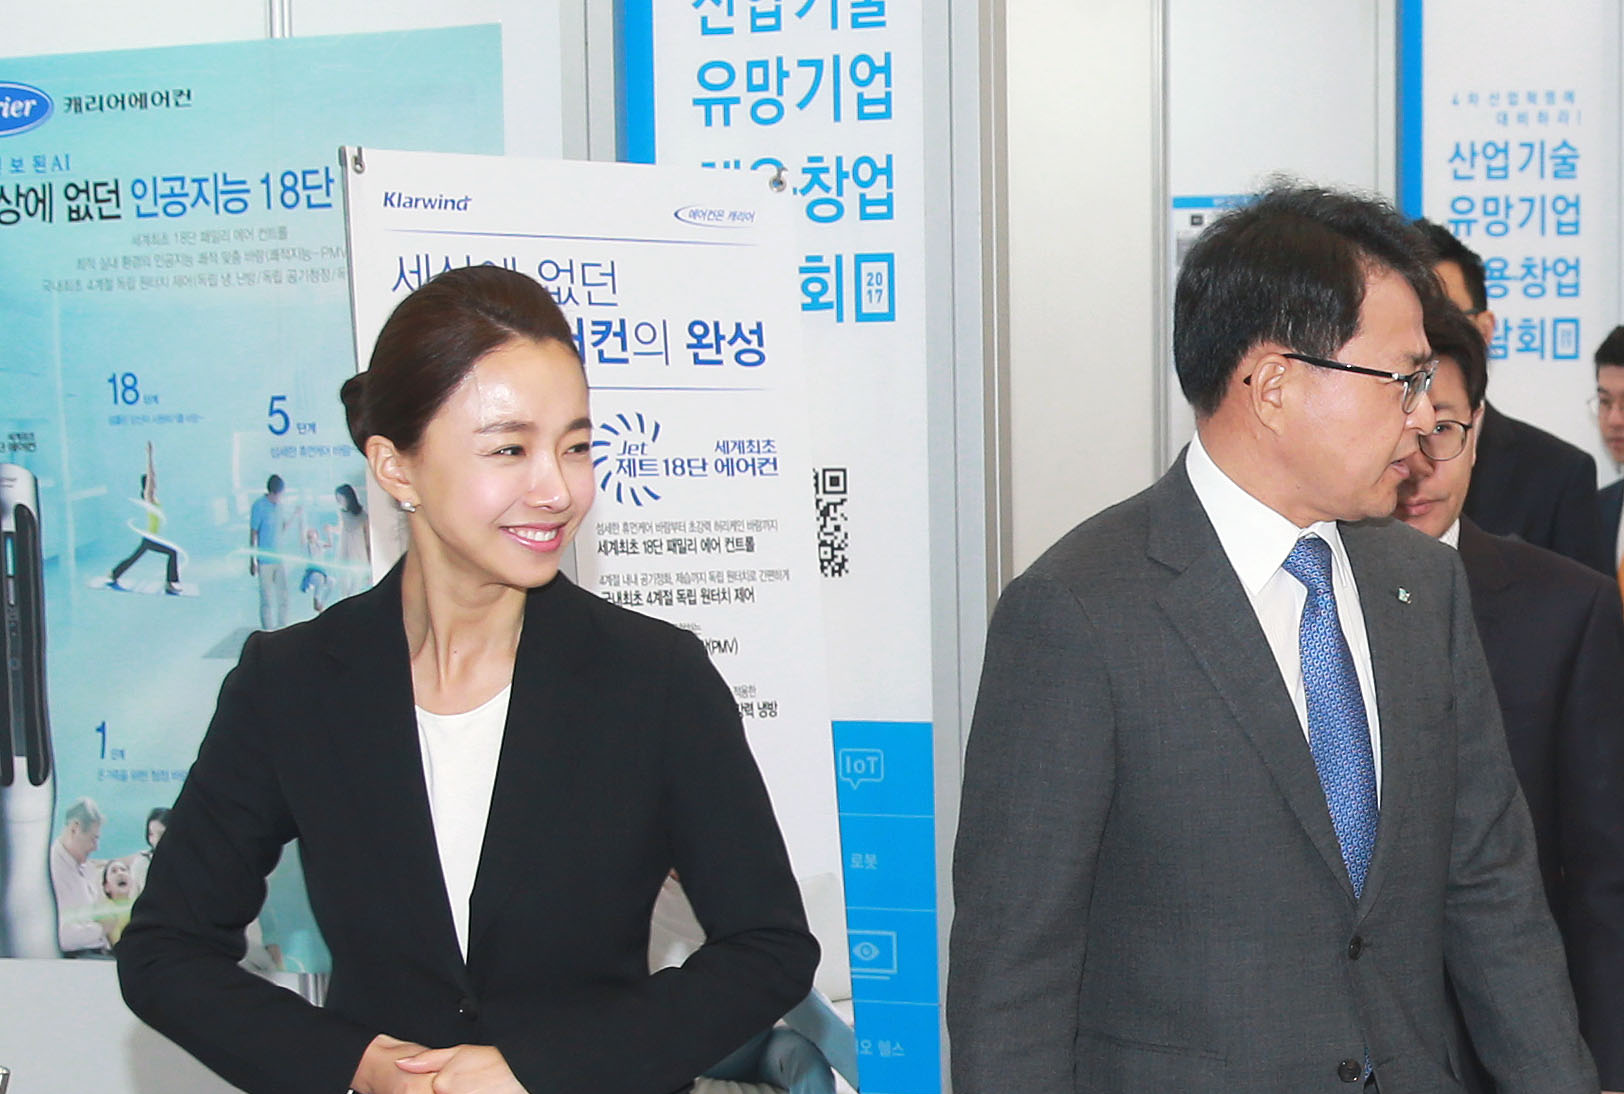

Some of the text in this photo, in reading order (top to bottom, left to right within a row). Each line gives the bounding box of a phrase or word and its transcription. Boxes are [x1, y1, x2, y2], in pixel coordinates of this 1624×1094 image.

[692, 52, 893, 127] 유망기업
[0, 96, 38, 119] ier
[64, 89, 192, 114] 캐리어에어컨
[1448, 139, 1580, 180] 산업기술
[65, 178, 121, 223] 없던
[131, 172, 250, 219] 인공지능
[260, 166, 335, 210] 18단
[383, 192, 473, 212] Klarwind
[1448, 194, 1581, 237] 유망기업
[537, 258, 619, 306] 없던
[866, 271, 884, 287] 20
[866, 288, 884, 304] 17
[686, 319, 767, 367] 완성
[107, 372, 139, 405] 18
[267, 395, 290, 435] 5
[616, 440, 649, 456] Jet
[715, 439, 778, 455] 세계최초
[714, 457, 779, 478] 에어컨
[597, 537, 640, 556] 세계최초
[643, 539, 664, 555] 18단
[701, 536, 722, 555] 에어
[646, 587, 674, 606] 4계절
[676, 586, 698, 606] 독립
[700, 586, 731, 605] 원터치
[734, 585, 756, 604] 제어
[845, 756, 879, 775] IoT
[850, 853, 878, 869] 로봇
